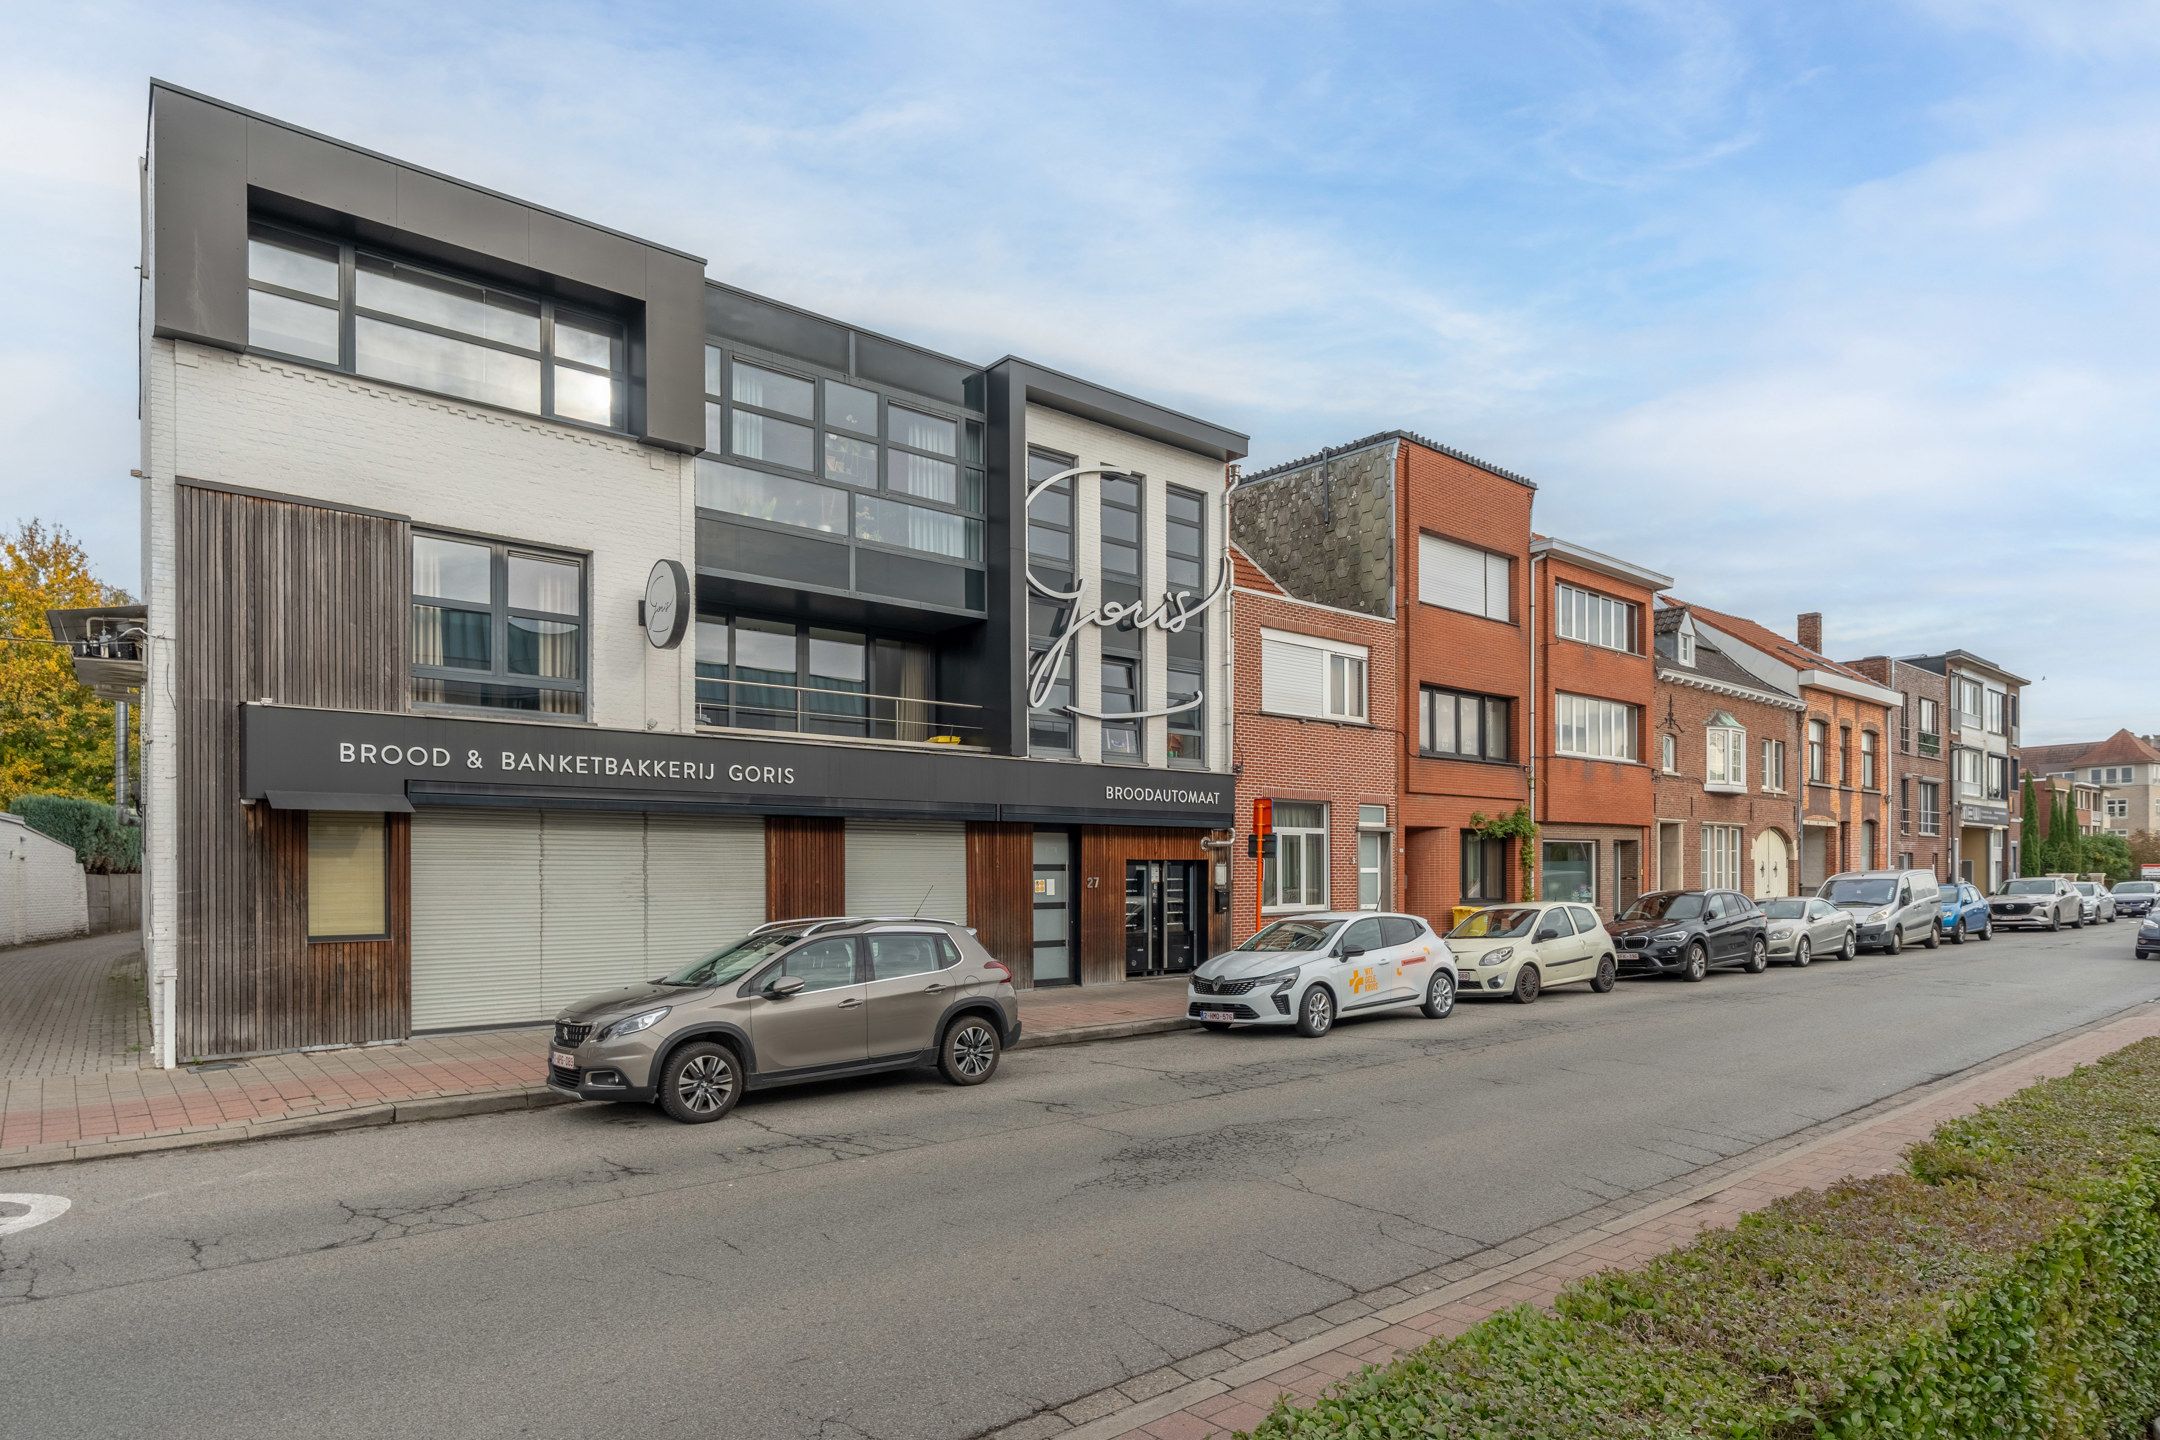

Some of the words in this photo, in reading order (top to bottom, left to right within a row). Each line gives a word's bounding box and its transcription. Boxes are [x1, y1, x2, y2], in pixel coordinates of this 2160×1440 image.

[339, 742, 451, 768] BROOD
[467, 749, 484, 769] &
[501, 752, 715, 780] BANKETBAKKERIJ
[728, 764, 796, 785] GORIS
[1105, 786, 1220, 805] BROODAUTOMAAT
[1087, 877, 1100, 888] 27
